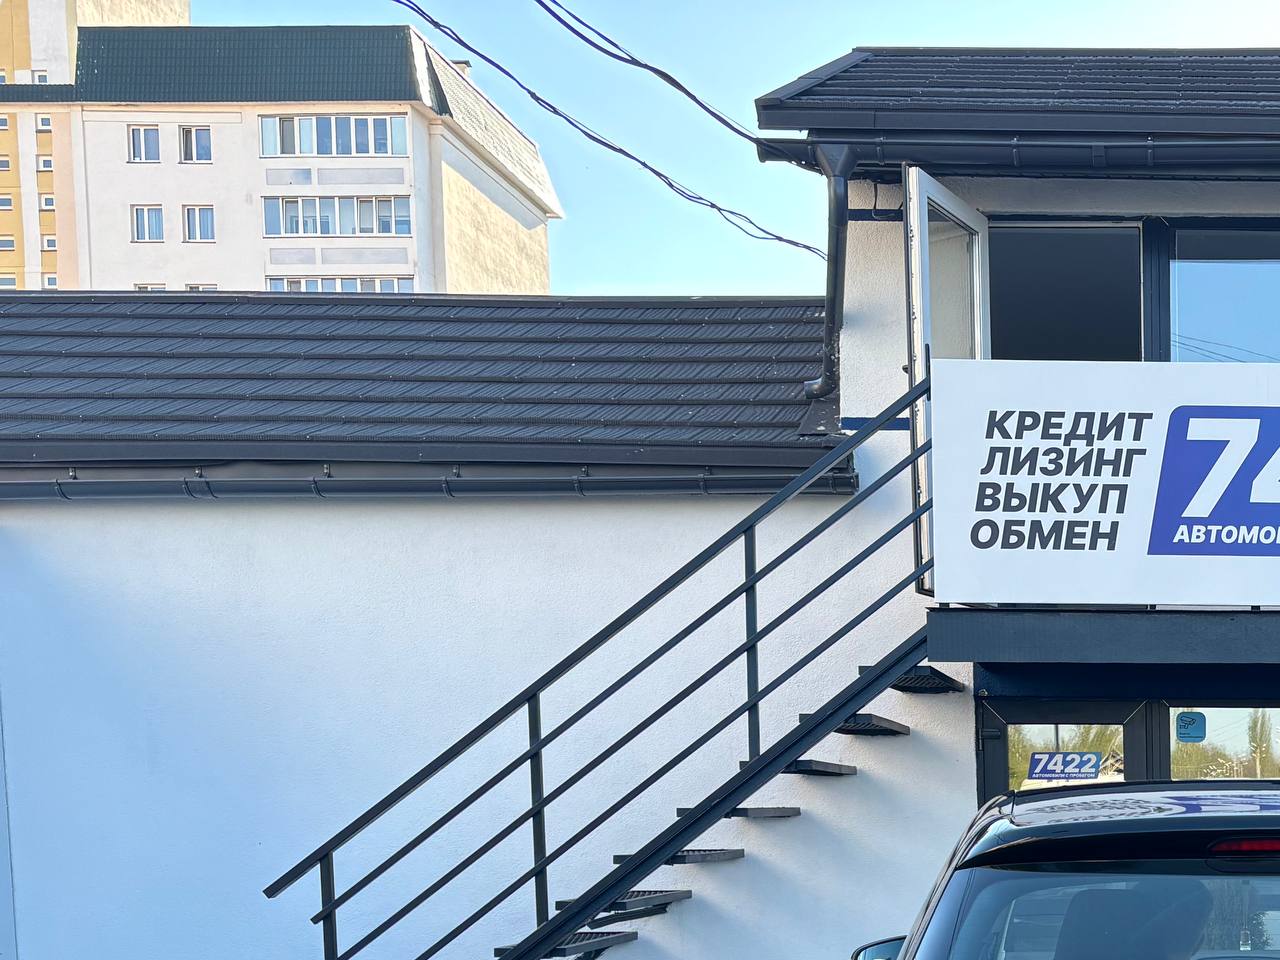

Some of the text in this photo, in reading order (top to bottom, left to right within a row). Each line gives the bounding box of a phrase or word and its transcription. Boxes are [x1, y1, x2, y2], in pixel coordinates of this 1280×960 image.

[985, 410, 1153, 447] КРЕДИТ
[980, 446, 1147, 477] ЛИЗИНГ
[974, 482, 1129, 514] ВЫКУП
[970, 518, 1120, 551] ОБМЕН
[1033, 753, 1097, 773] 7422
